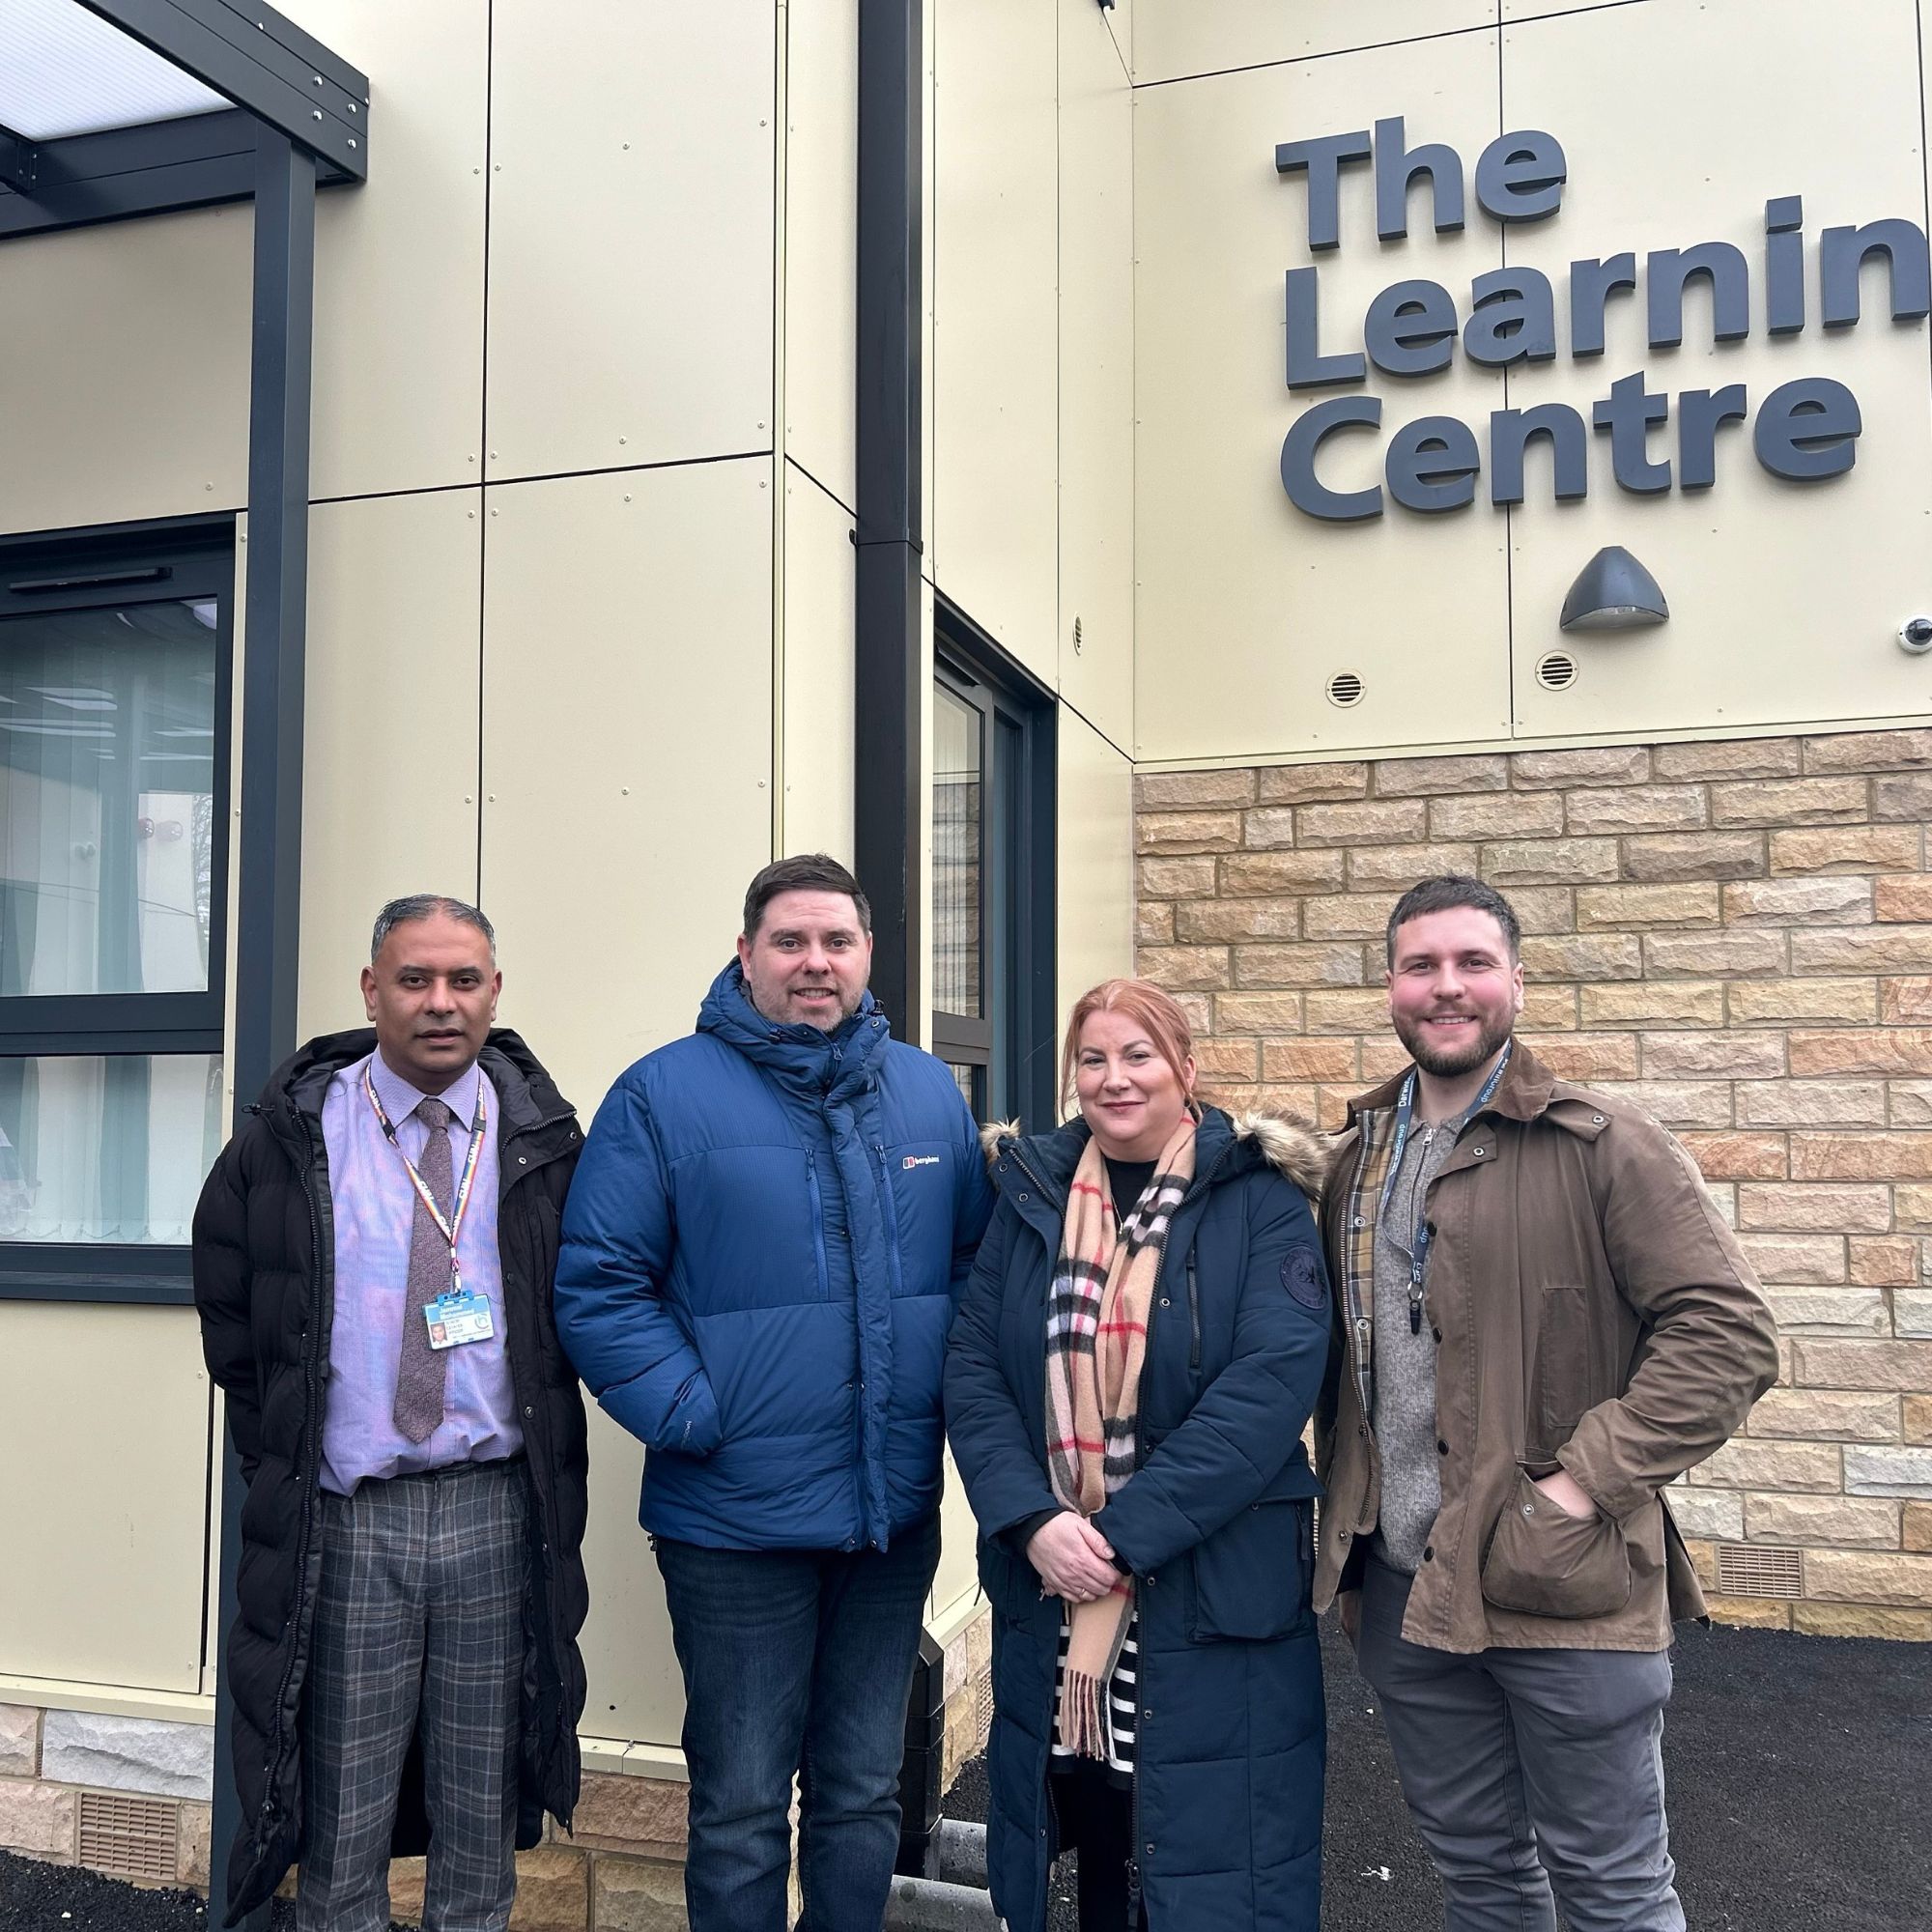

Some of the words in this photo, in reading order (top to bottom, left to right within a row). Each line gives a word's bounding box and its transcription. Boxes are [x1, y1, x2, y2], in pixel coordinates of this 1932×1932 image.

[1275, 116, 1567, 252] The
[1286, 194, 1931, 390] Learnin
[1280, 371, 1861, 523] Centre
